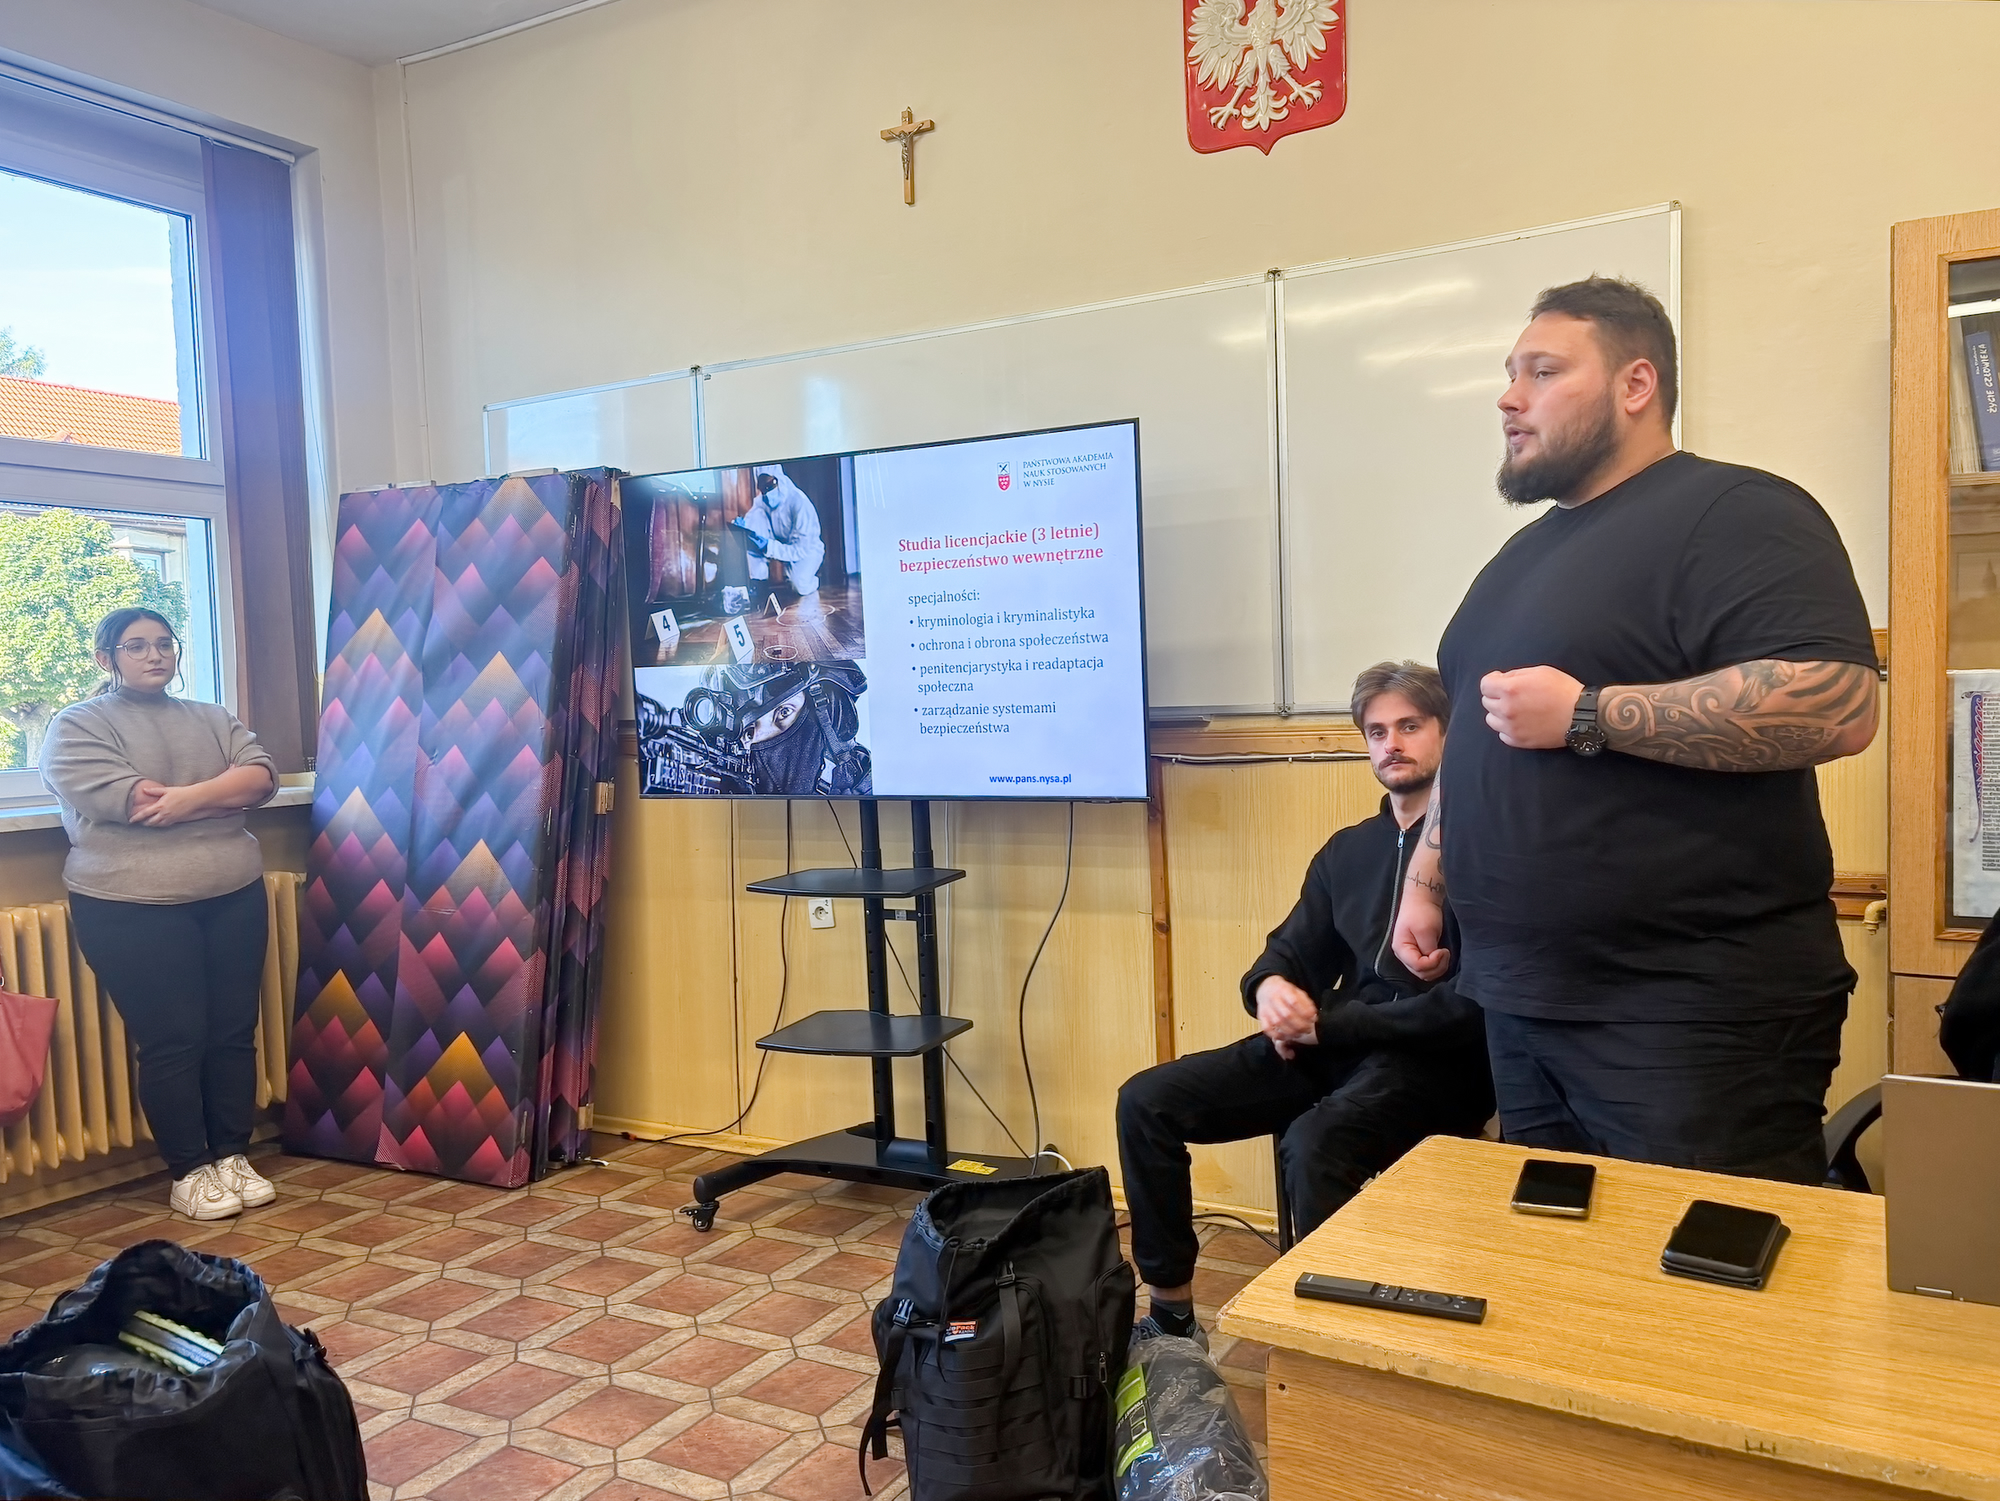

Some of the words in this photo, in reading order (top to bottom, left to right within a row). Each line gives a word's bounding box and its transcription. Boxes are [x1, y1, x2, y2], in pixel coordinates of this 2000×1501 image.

[1978, 343, 1994, 388] CZŁOWIEKA
[1986, 389, 1998, 414] ŻYCIE
[1022, 456, 1071, 469] PAŃSTWOWA
[1072, 452, 1114, 464] AKADEMIA
[1023, 469, 1046, 479] NAUK
[1046, 462, 1107, 476] STOSOWANYCH
[1023, 480, 1031, 488] W
[1032, 477, 1055, 487] NYSIE
[898, 537, 942, 552] Studia
[944, 530, 1028, 549] licencjackie
[1031, 526, 1047, 544] (3
[1050, 522, 1100, 541] letnie)
[899, 553, 1010, 574] bezpieczeństwo
[1012, 546, 1104, 565] wewnętrzne
[908, 589, 981, 607] specjalności:
[662, 615, 671, 631] 4
[917, 613, 994, 630] kryminologia
[996, 612, 1001, 624] i
[1003, 606, 1095, 626] kryminalistyka
[733, 624, 745, 647] 5
[918, 638, 965, 652] ochrona
[967, 637, 972, 649] i
[974, 635, 1016, 649] obrona
[1018, 631, 1109, 650] społeczeństwa
[920, 660, 1022, 677] penitencjarystyka
[1025, 659, 1029, 671] i
[1032, 656, 1104, 672] readaptacja
[917, 680, 974, 696] społeczna
[921, 703, 990, 718] zarządzanie
[992, 701, 1057, 718] systemami
[919, 721, 1010, 737] bezpieczeństwa
[989, 774, 1072, 785] www.pans.nysa.pl
